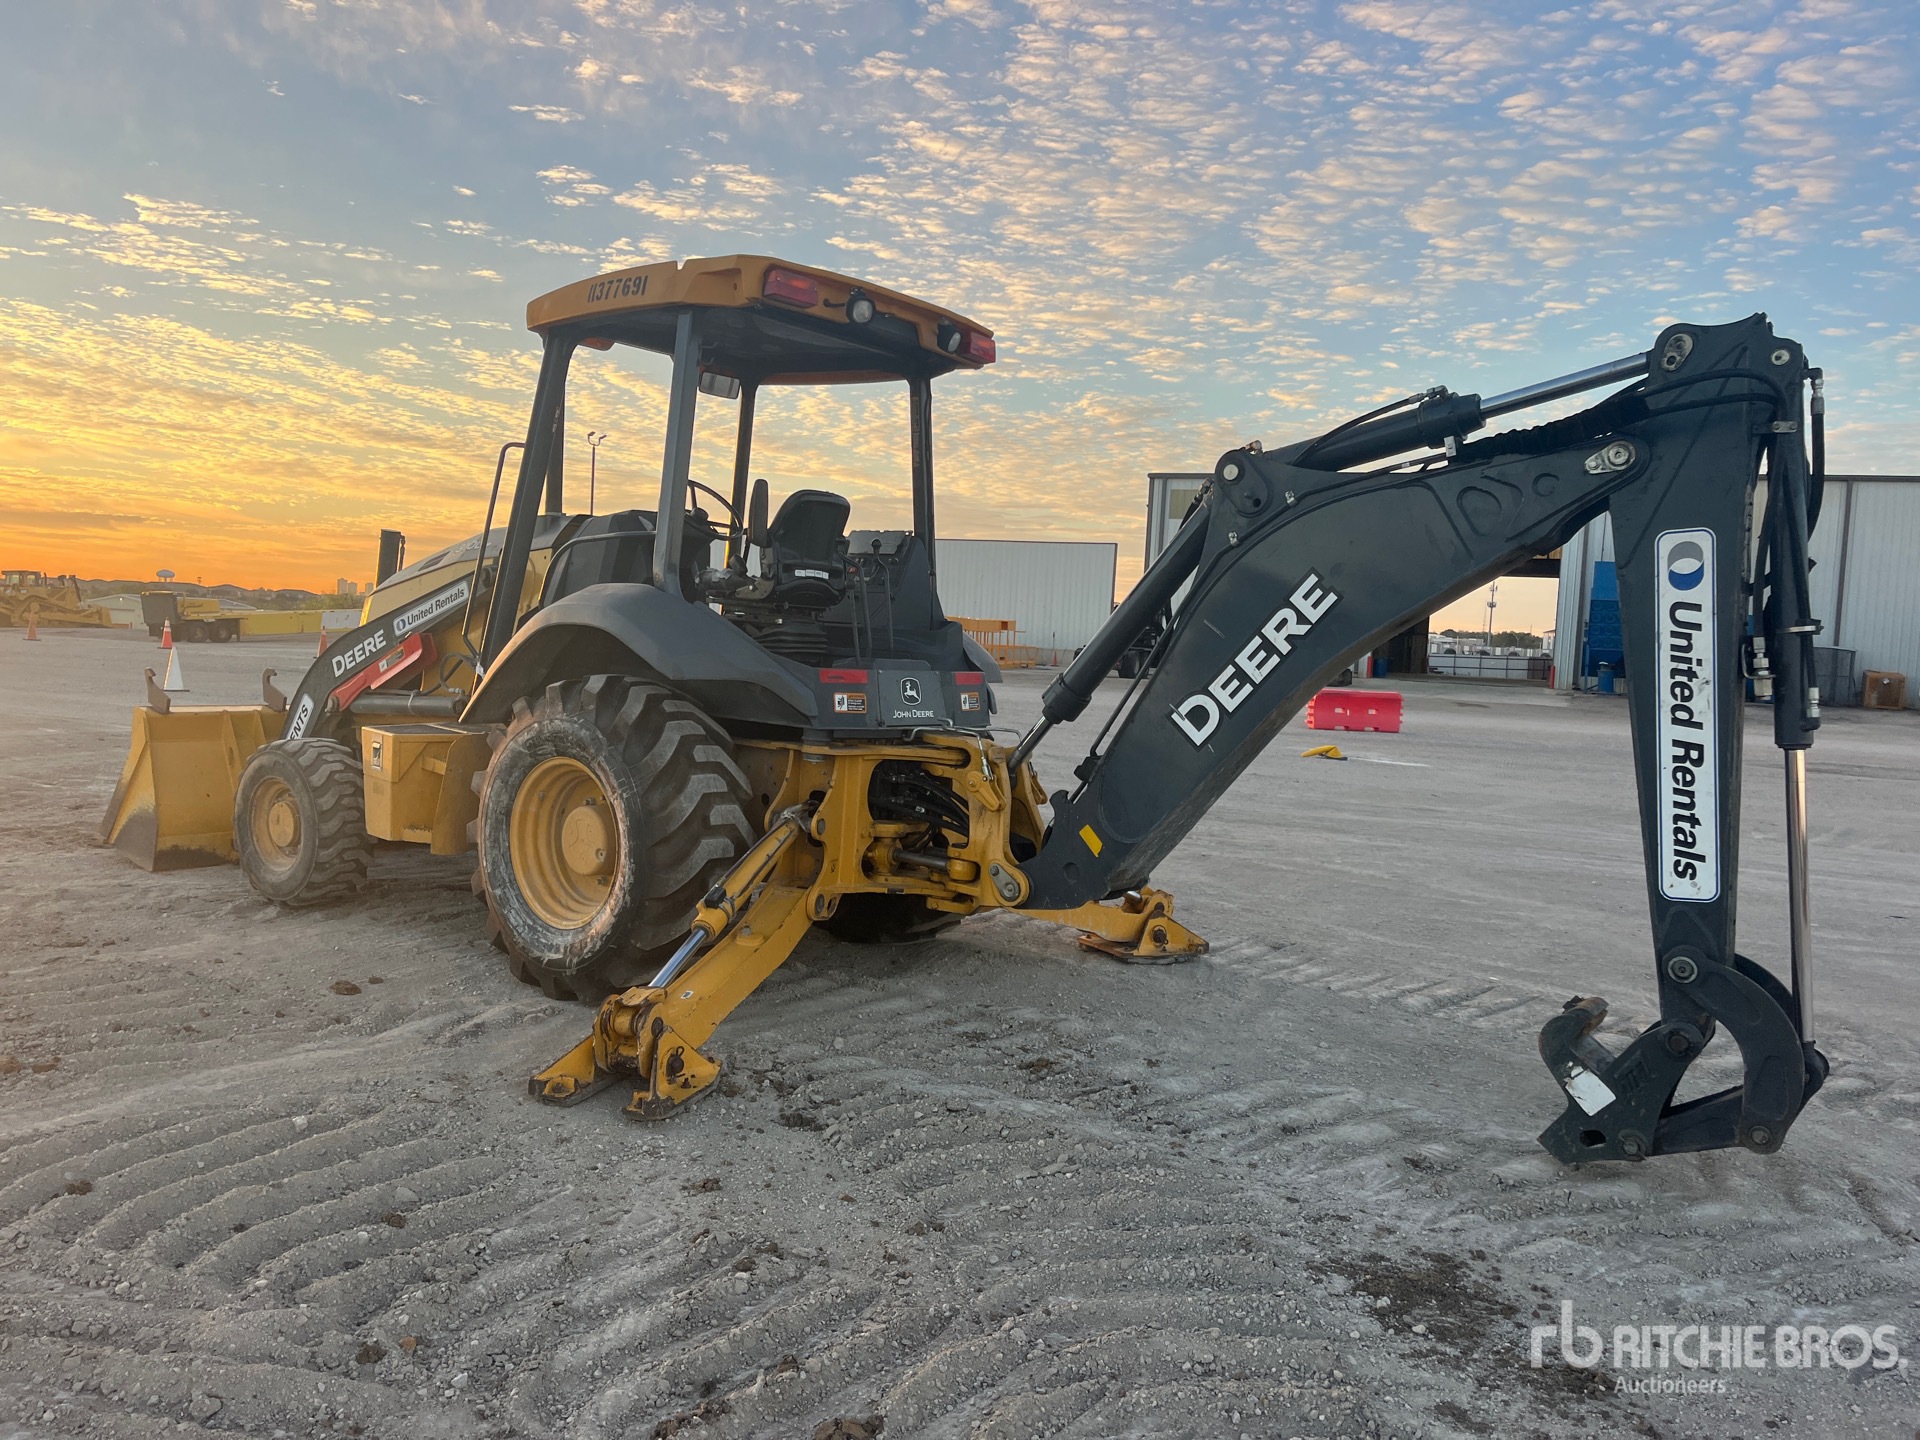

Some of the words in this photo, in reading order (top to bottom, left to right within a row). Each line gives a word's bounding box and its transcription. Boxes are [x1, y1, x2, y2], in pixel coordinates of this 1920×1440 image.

[587, 275, 649, 303] 11377691
[407, 602, 434, 626] United
[435, 587, 466, 611] Rentals
[331, 629, 387, 678] DEERE
[1171, 573, 1338, 747] DEERE
[1669, 601, 1703, 730] United
[893, 710, 912, 718] JOHN
[912, 709, 934, 718] DEERE
[1672, 739, 1706, 881] Rentals
